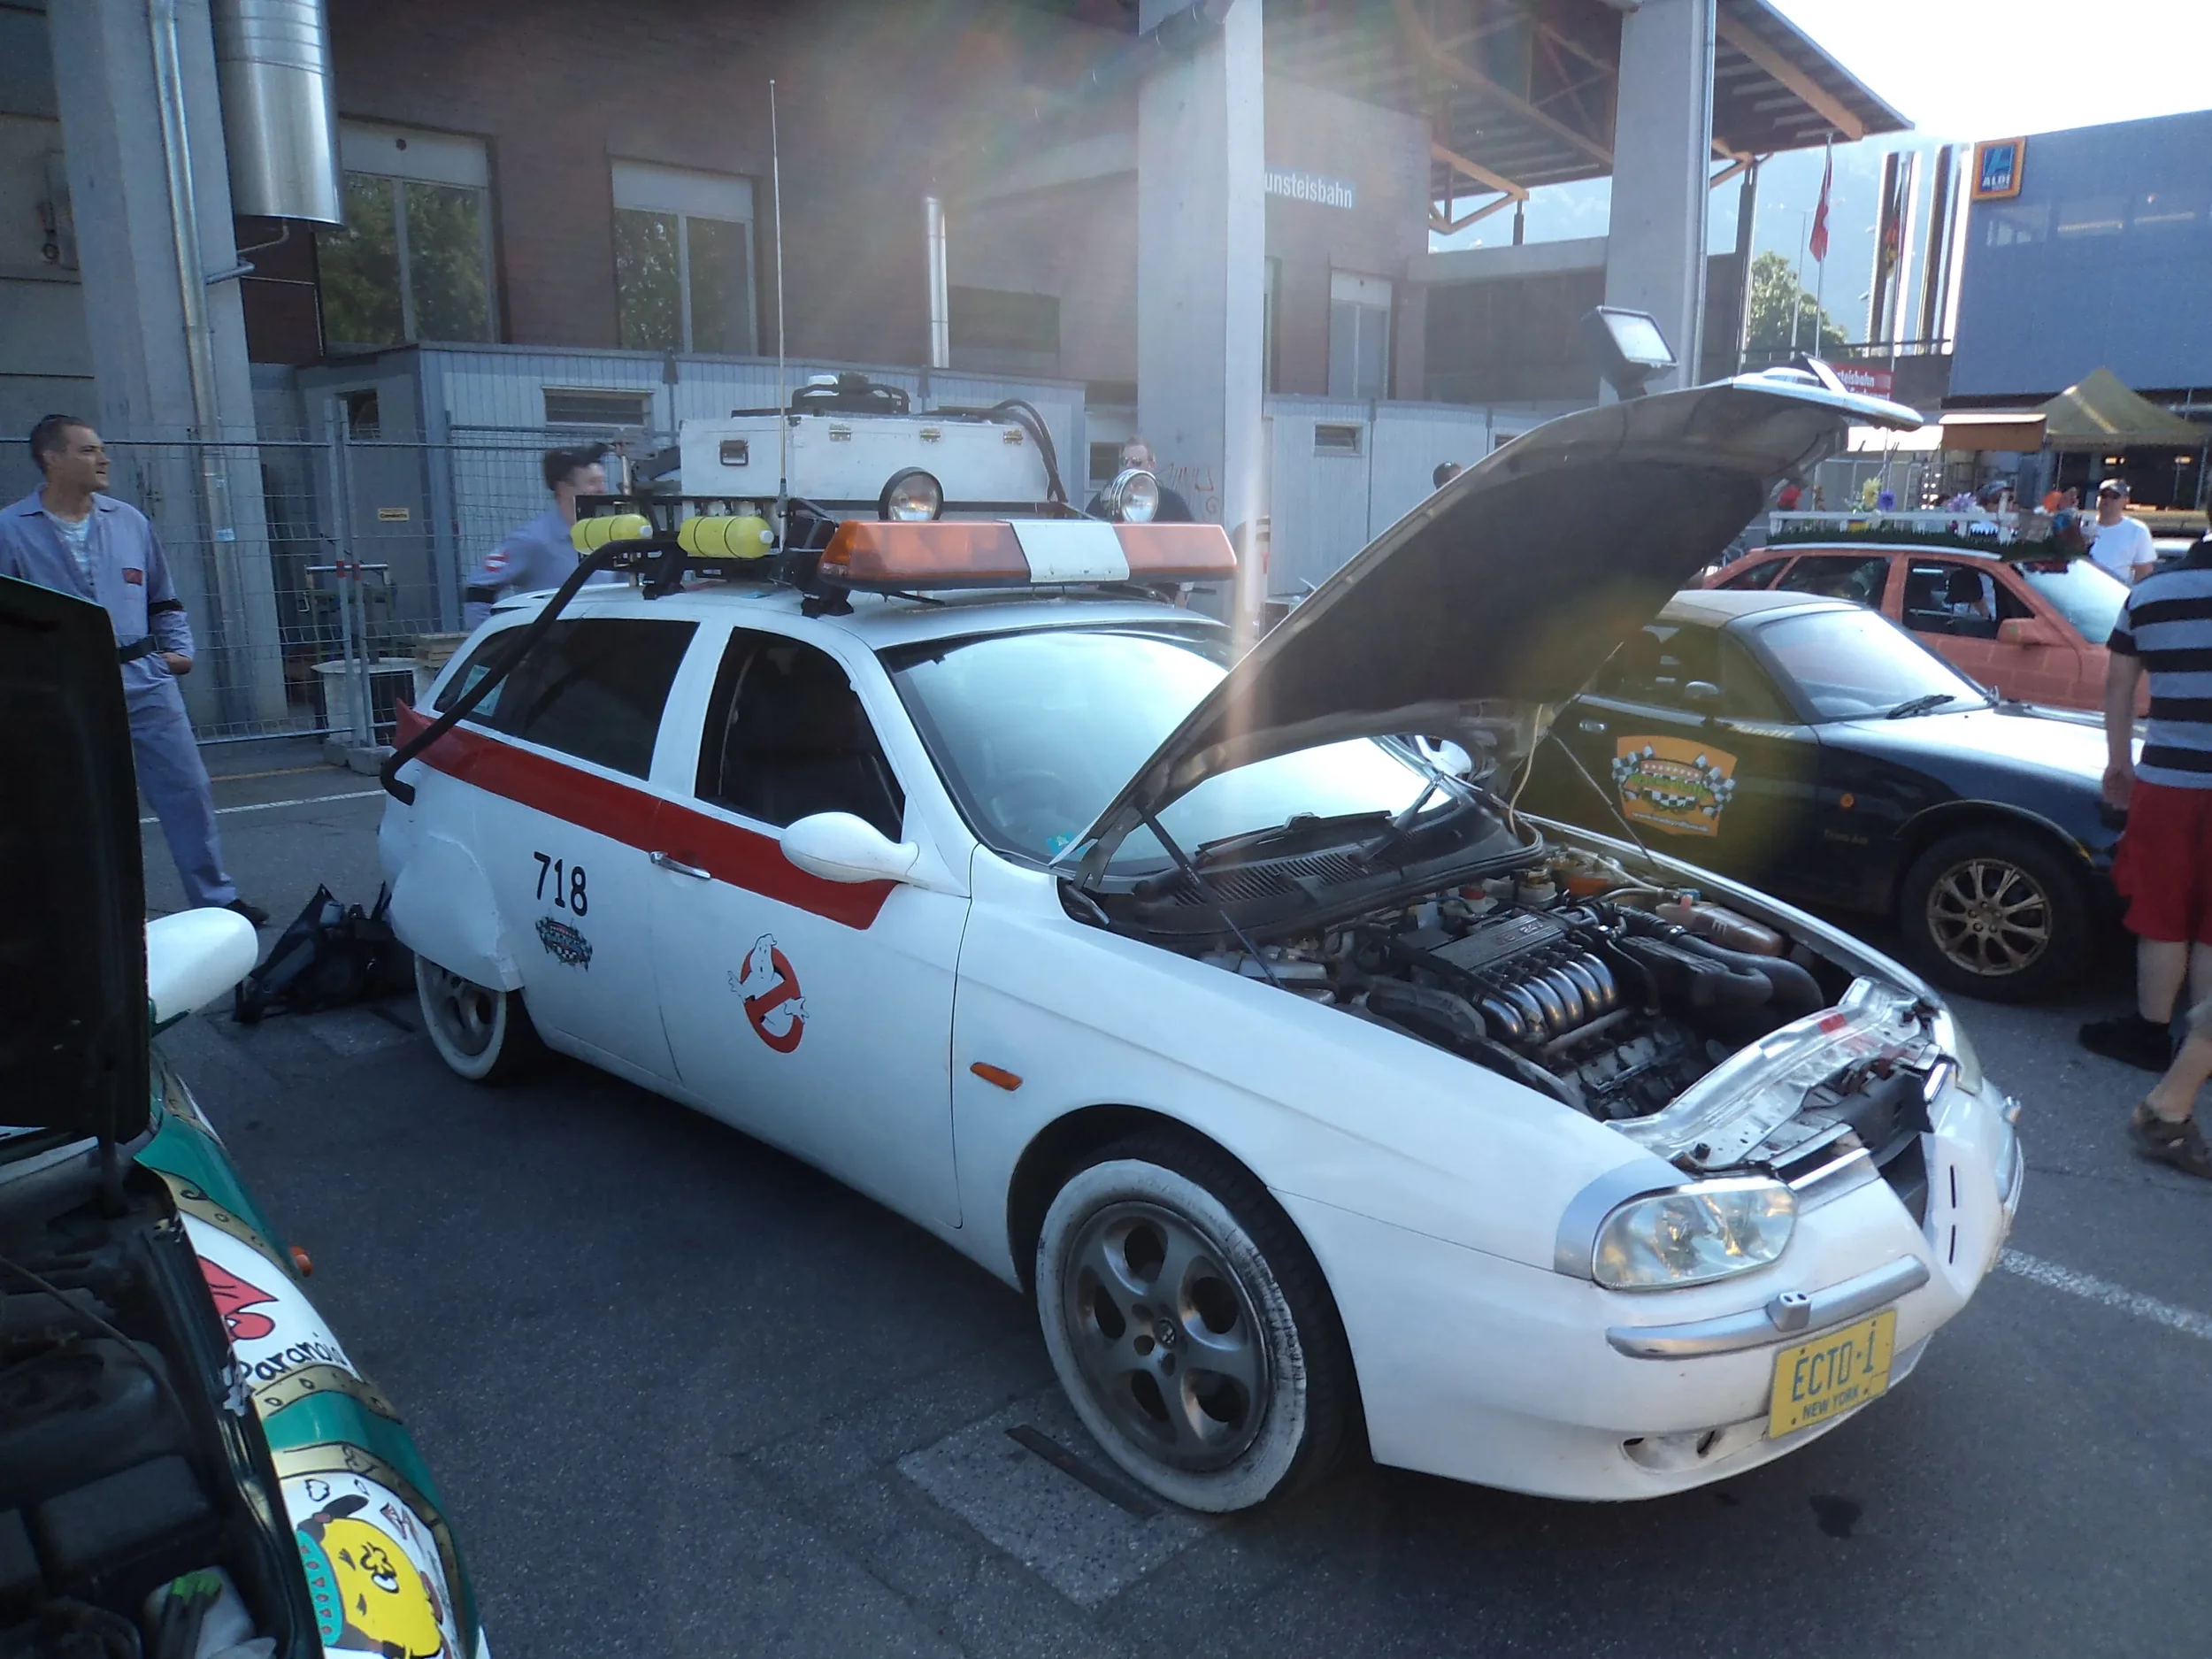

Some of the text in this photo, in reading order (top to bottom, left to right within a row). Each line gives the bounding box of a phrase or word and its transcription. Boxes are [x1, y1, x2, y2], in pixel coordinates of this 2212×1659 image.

[1982, 174, 2010, 187] ALDI
[534, 850, 588, 917] 718
[1802, 1384, 1859, 1420] NEW YORK
